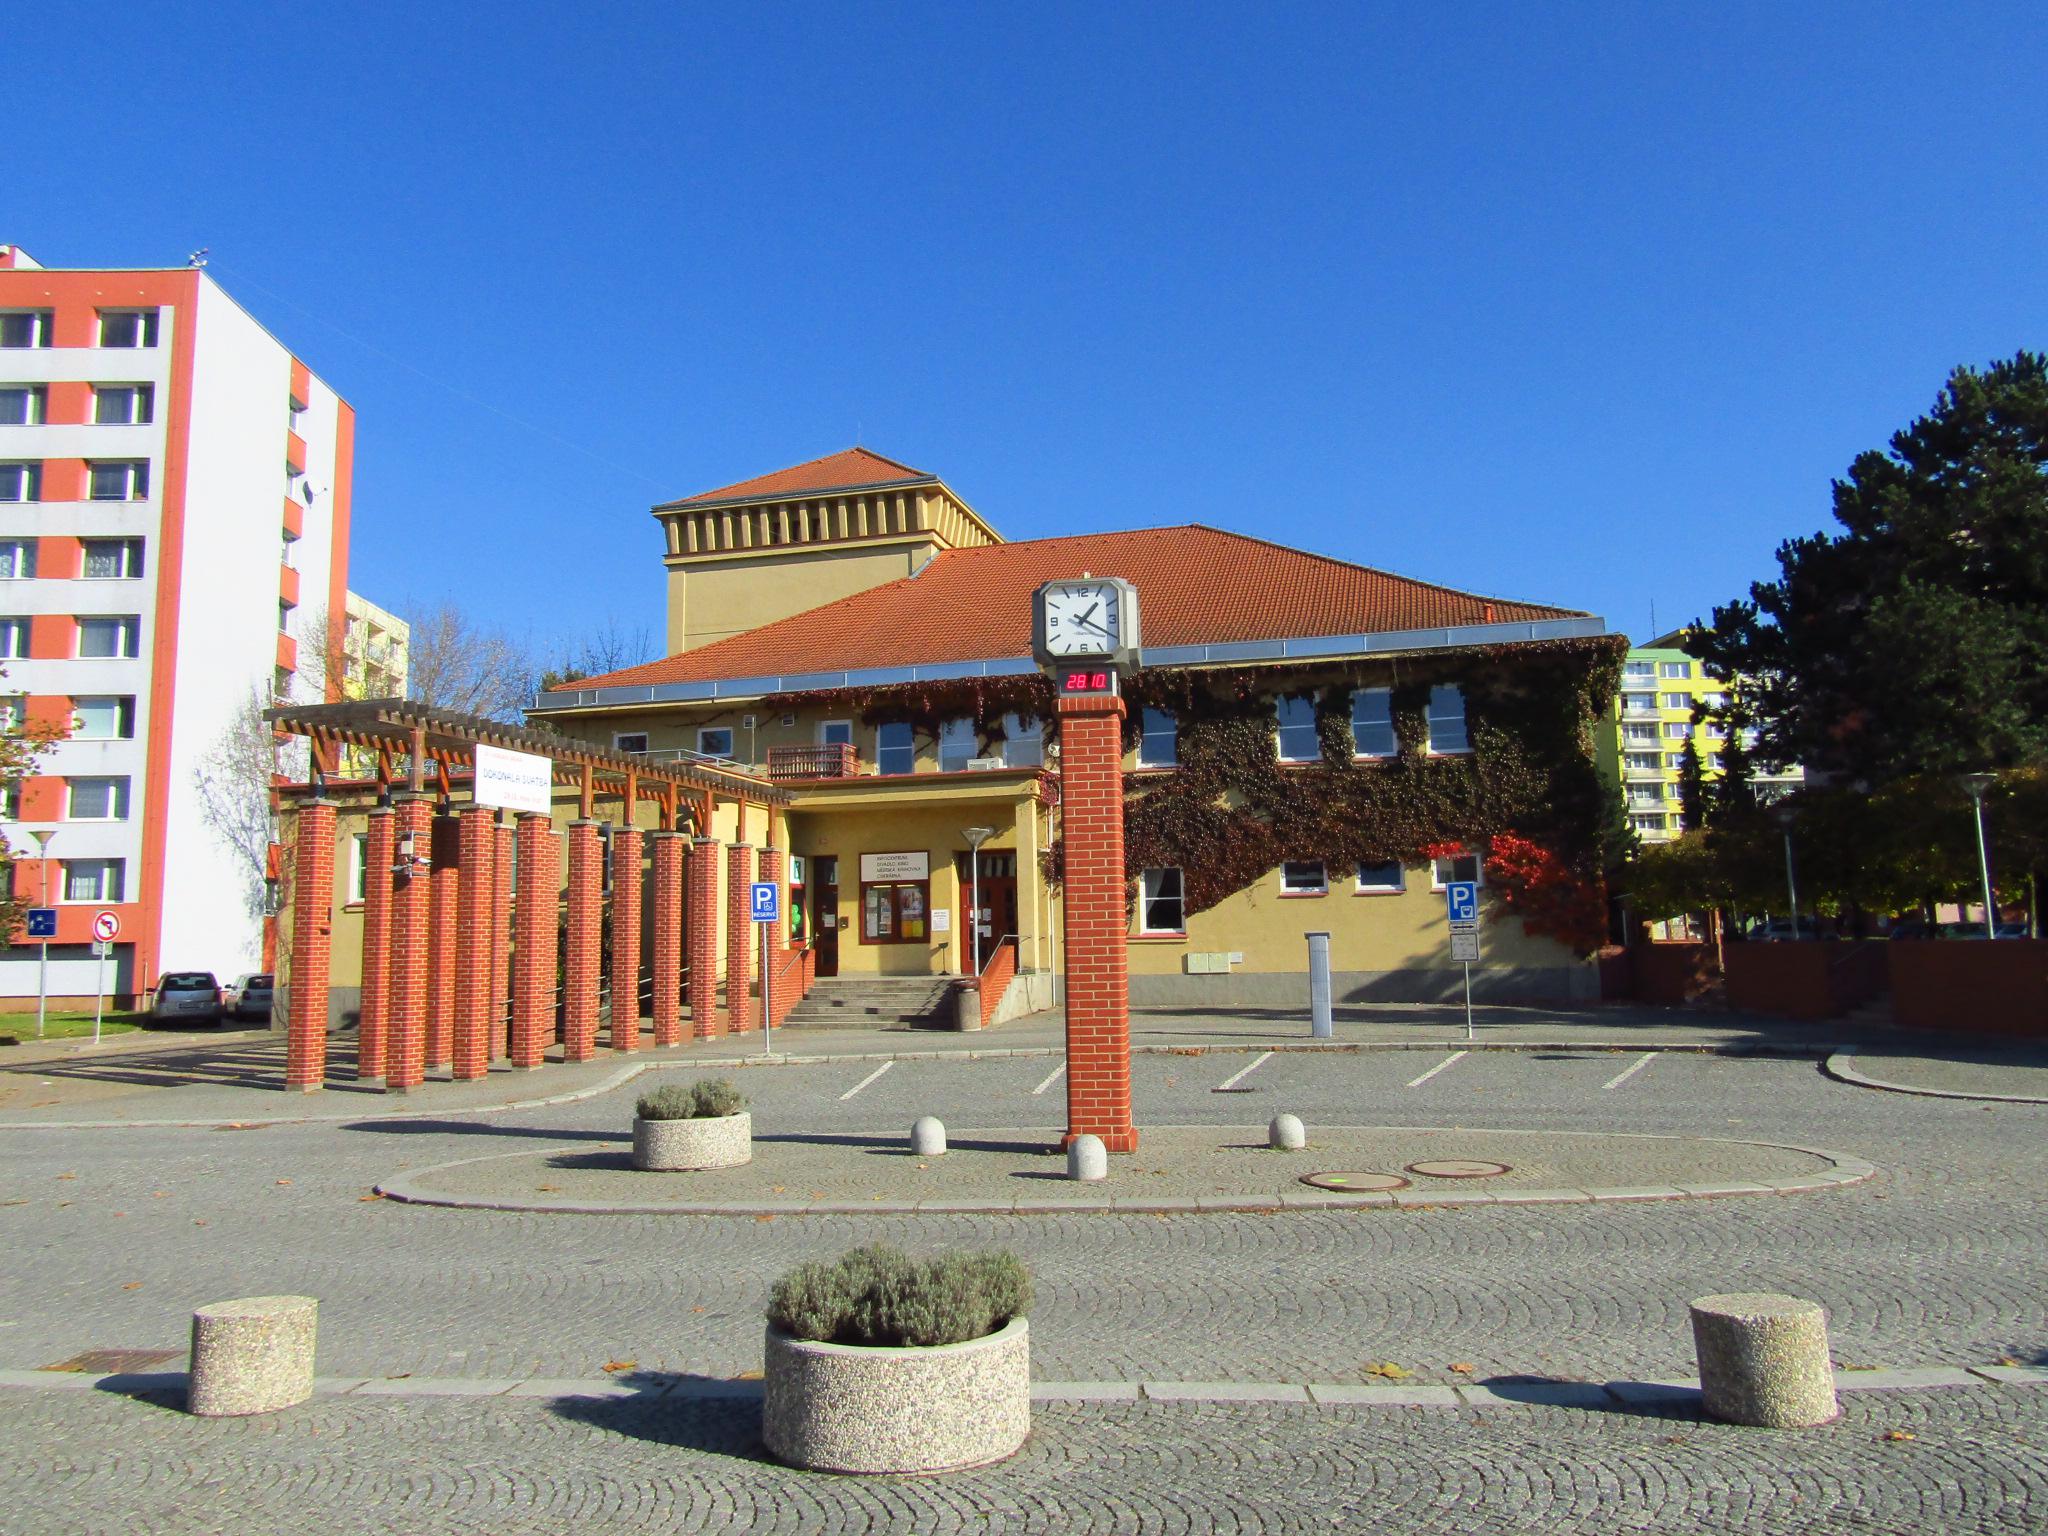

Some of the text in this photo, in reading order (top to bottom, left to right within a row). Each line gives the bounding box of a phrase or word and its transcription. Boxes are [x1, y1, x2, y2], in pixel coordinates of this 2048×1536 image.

[1077, 587, 1089, 598] 12
[1050, 617, 1058, 627] 9
[1108, 614, 1117, 624] 3
[1079, 643, 1088, 653] 6
[756, 887, 772, 909] P
[1452, 886, 1470, 910] P
